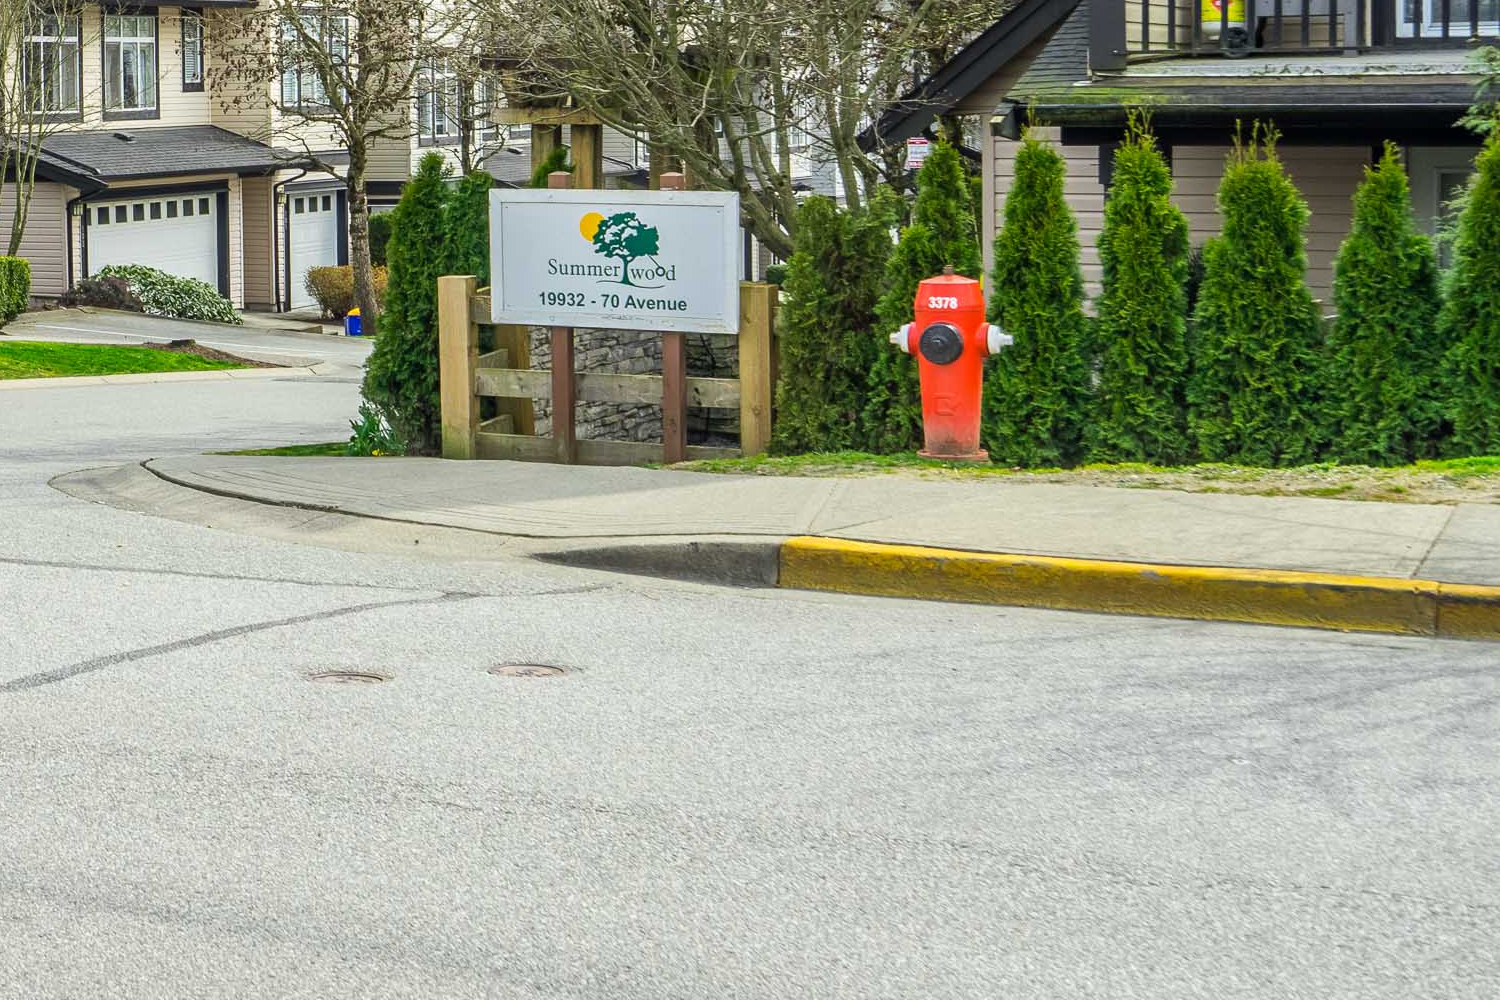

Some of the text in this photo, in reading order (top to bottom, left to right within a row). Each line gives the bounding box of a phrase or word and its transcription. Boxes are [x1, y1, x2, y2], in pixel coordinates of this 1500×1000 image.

[539, 291, 586, 307] 19932
[601, 294, 620, 309] 70
[624, 295, 688, 311] Avenue
[928, 297, 958, 309] 3378
